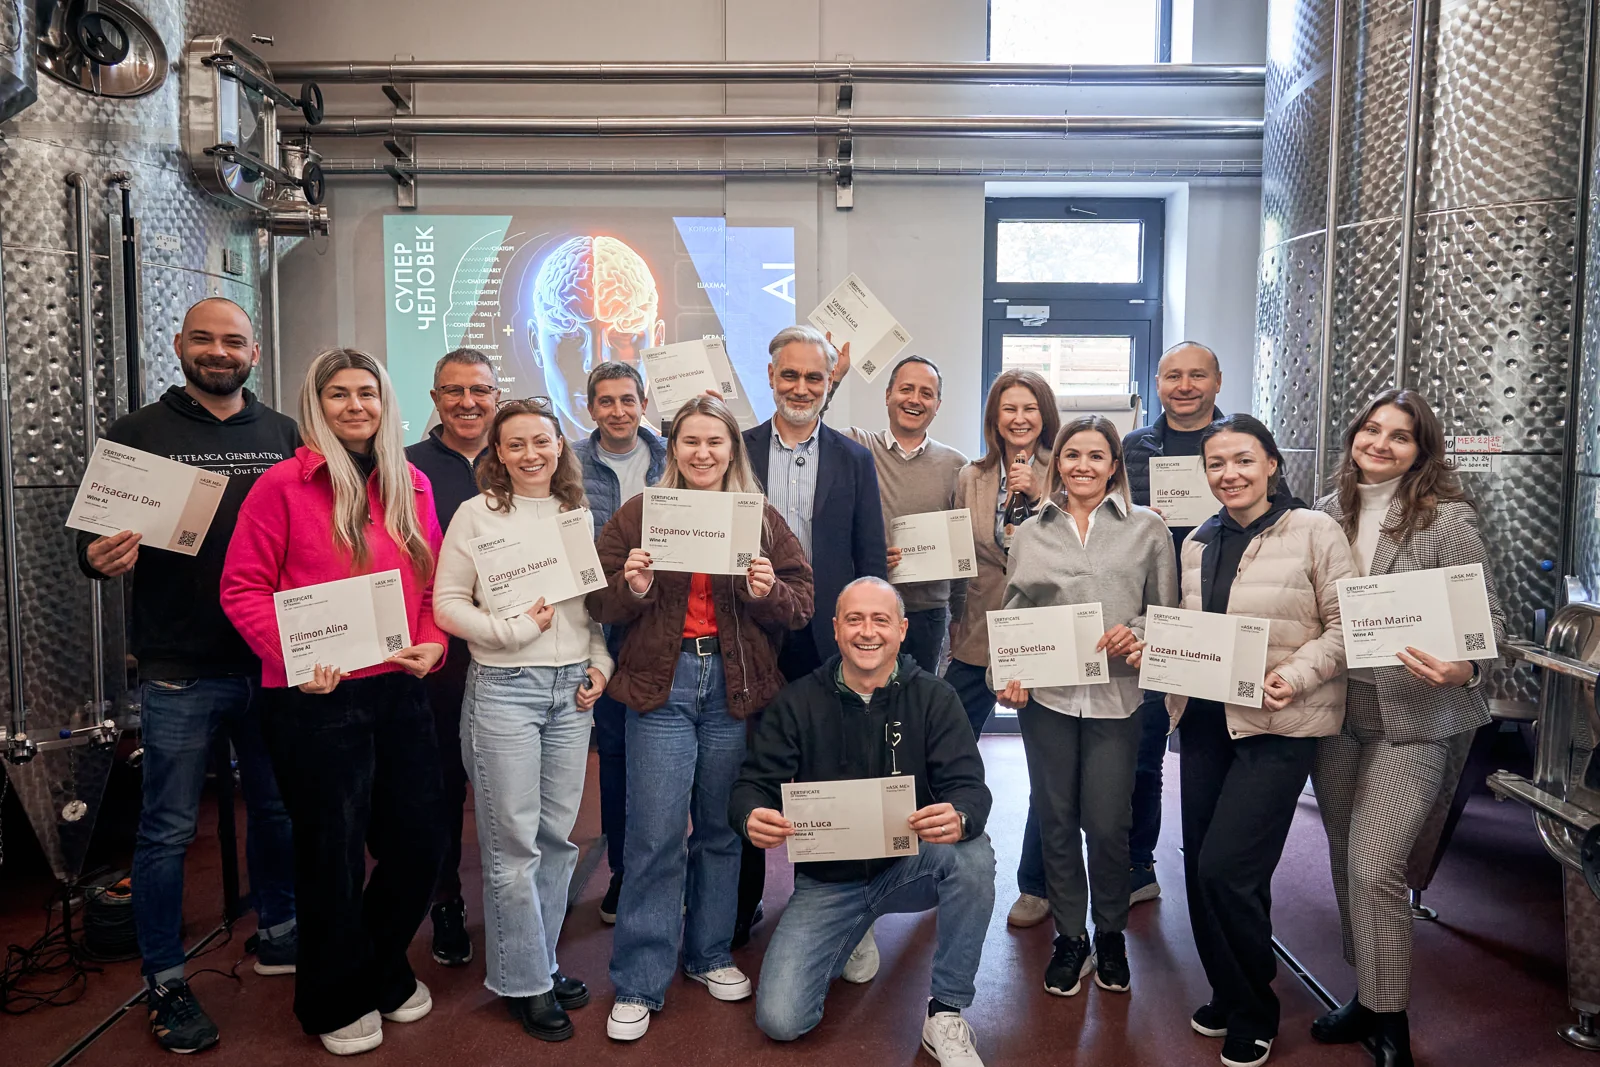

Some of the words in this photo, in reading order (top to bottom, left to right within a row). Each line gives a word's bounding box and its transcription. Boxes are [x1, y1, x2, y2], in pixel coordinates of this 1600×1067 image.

[394, 243, 413, 313] СУПЕР
[415, 226, 435, 330] ЧЕЛОВЕК
[761, 262, 795, 304] AI
[831, 298, 847, 316] Vasile
[845, 313, 859, 329] Luca
[654, 374, 678, 384] Goncear
[679, 369, 705, 379] Veaceslav
[103, 448, 136, 462] CERTIFICATE
[225, 451, 284, 461] GENERATION
[86, 494, 101, 502] Wine
[90, 482, 139, 502] Prisacaru
[141, 495, 161, 508] Dan
[1170, 489, 1190, 497] Gogu
[650, 526, 691, 537] Stepanov
[692, 529, 726, 539] Victoria
[477, 538, 506, 550] CERTIFICATE
[917, 544, 936, 552] Elena
[488, 566, 527, 583] Gangura
[527, 556, 558, 571] Natalia
[1346, 584, 1378, 592] CERTIFICATE
[283, 594, 313, 604] CERTIFICATE
[1153, 613, 1181, 621] CERTIFICATE
[1351, 617, 1382, 628] Trifan
[1384, 614, 1423, 625] Marina
[289, 629, 324, 643] Filimon
[325, 623, 349, 635] Alina
[997, 647, 1019, 655] Gogu
[1020, 643, 1056, 653] Svetlana
[1150, 645, 1177, 656] Lozan
[1180, 649, 1222, 662] Liudmila
[793, 821, 808, 829] Ion
[810, 820, 832, 828] Luca
